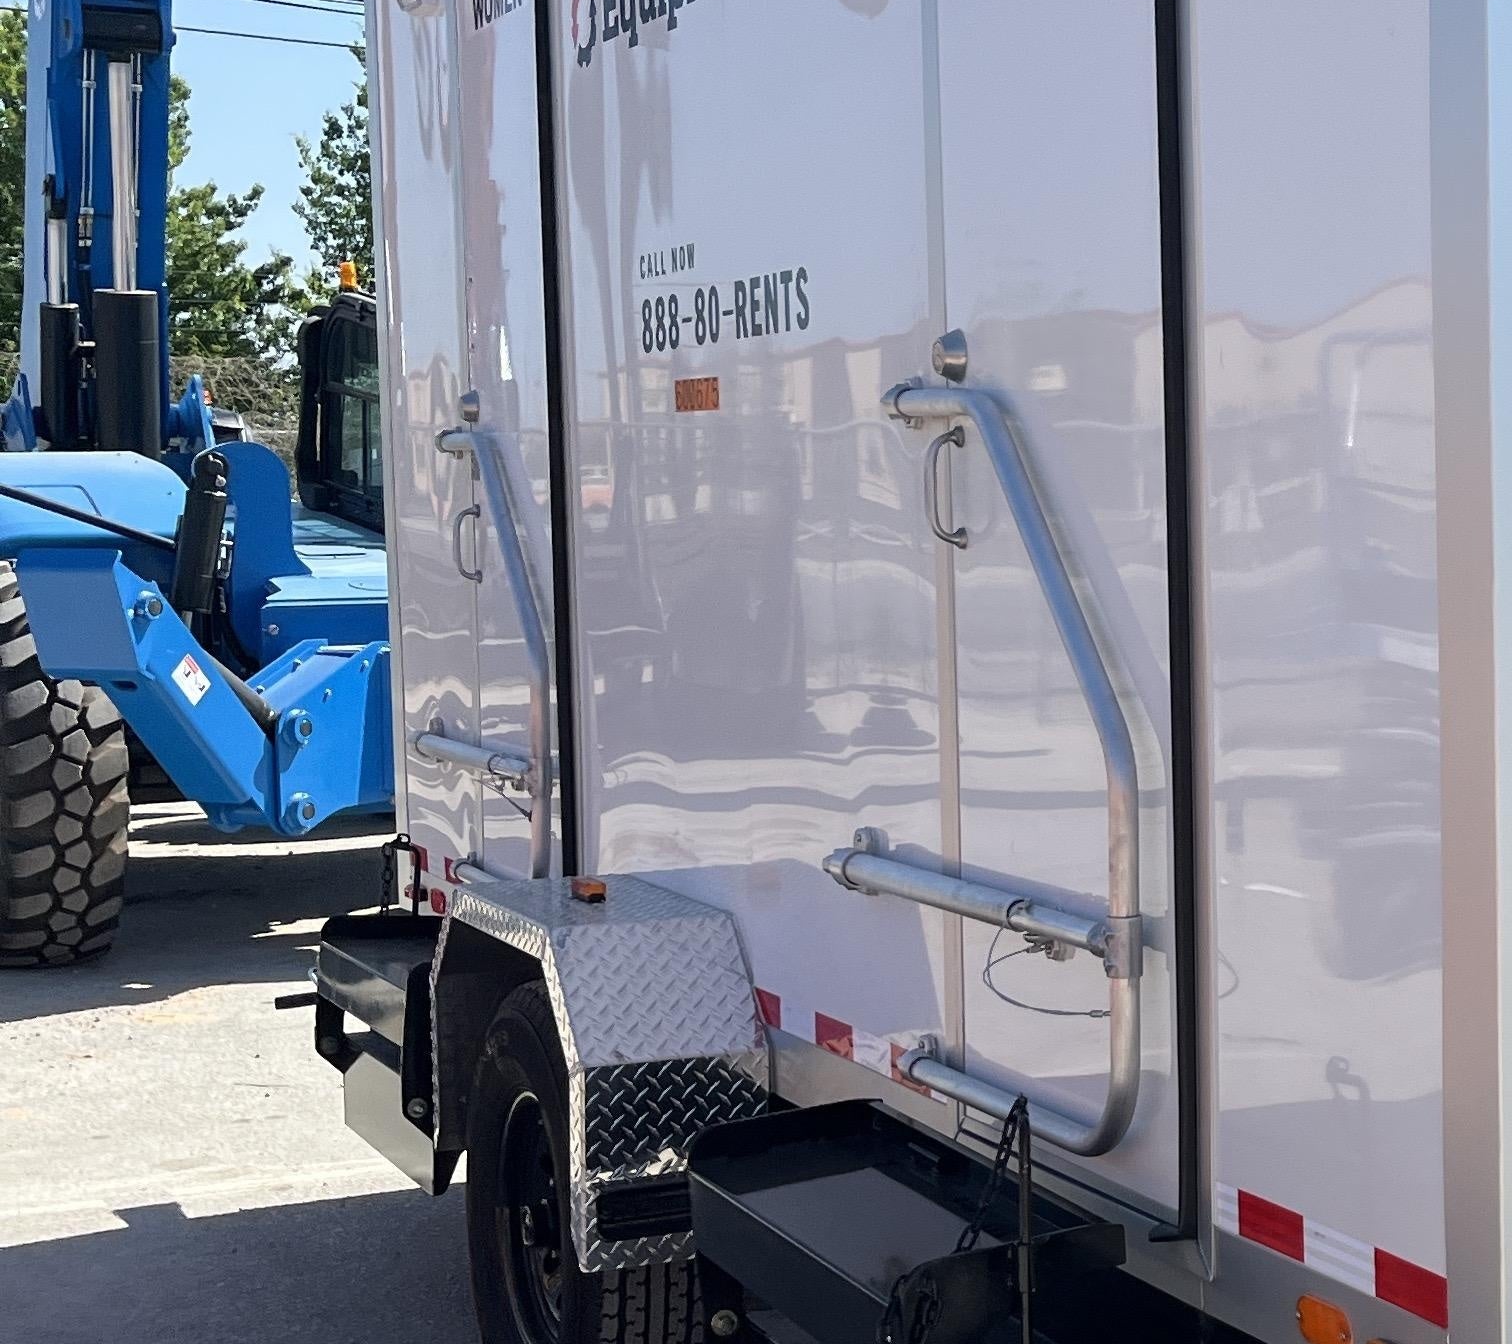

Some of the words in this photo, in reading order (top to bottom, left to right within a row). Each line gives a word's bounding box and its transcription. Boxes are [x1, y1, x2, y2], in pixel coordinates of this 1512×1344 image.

[639, 250, 667, 280] CALL
[670, 243, 695, 273] NOW
[641, 266, 811, 354] 888-80-RENTS
